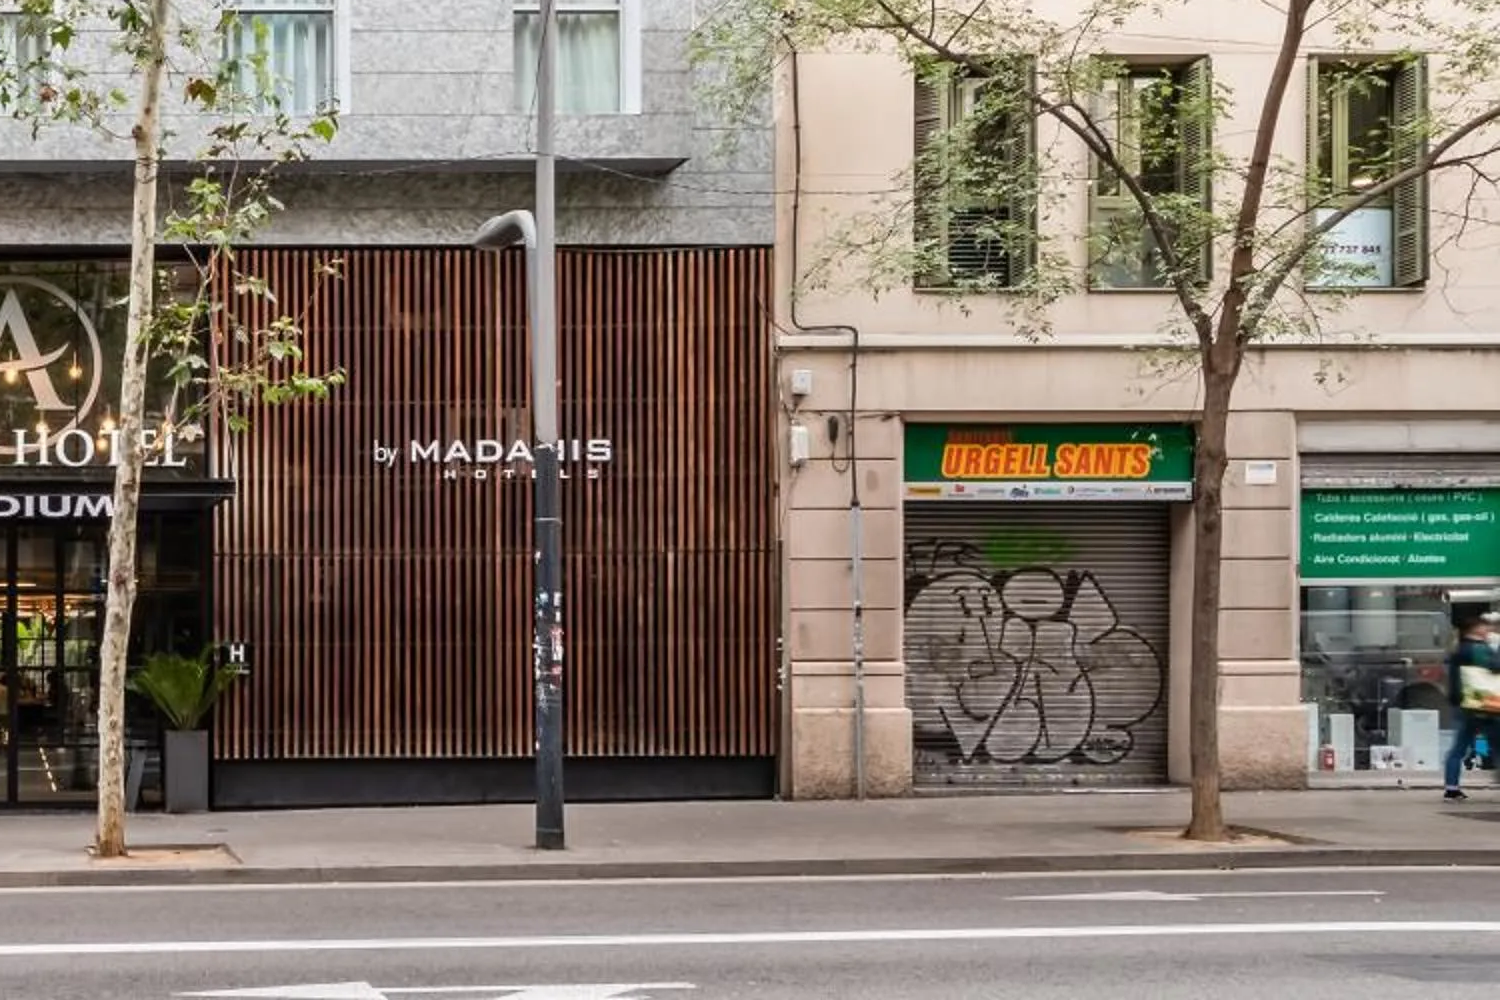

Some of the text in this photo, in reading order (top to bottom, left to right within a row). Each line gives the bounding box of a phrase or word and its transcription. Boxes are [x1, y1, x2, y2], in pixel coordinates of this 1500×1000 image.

[373, 440, 398, 467] by
[942, 443, 1151, 478] URGELL SANTS
[230, 643, 245, 663] H
